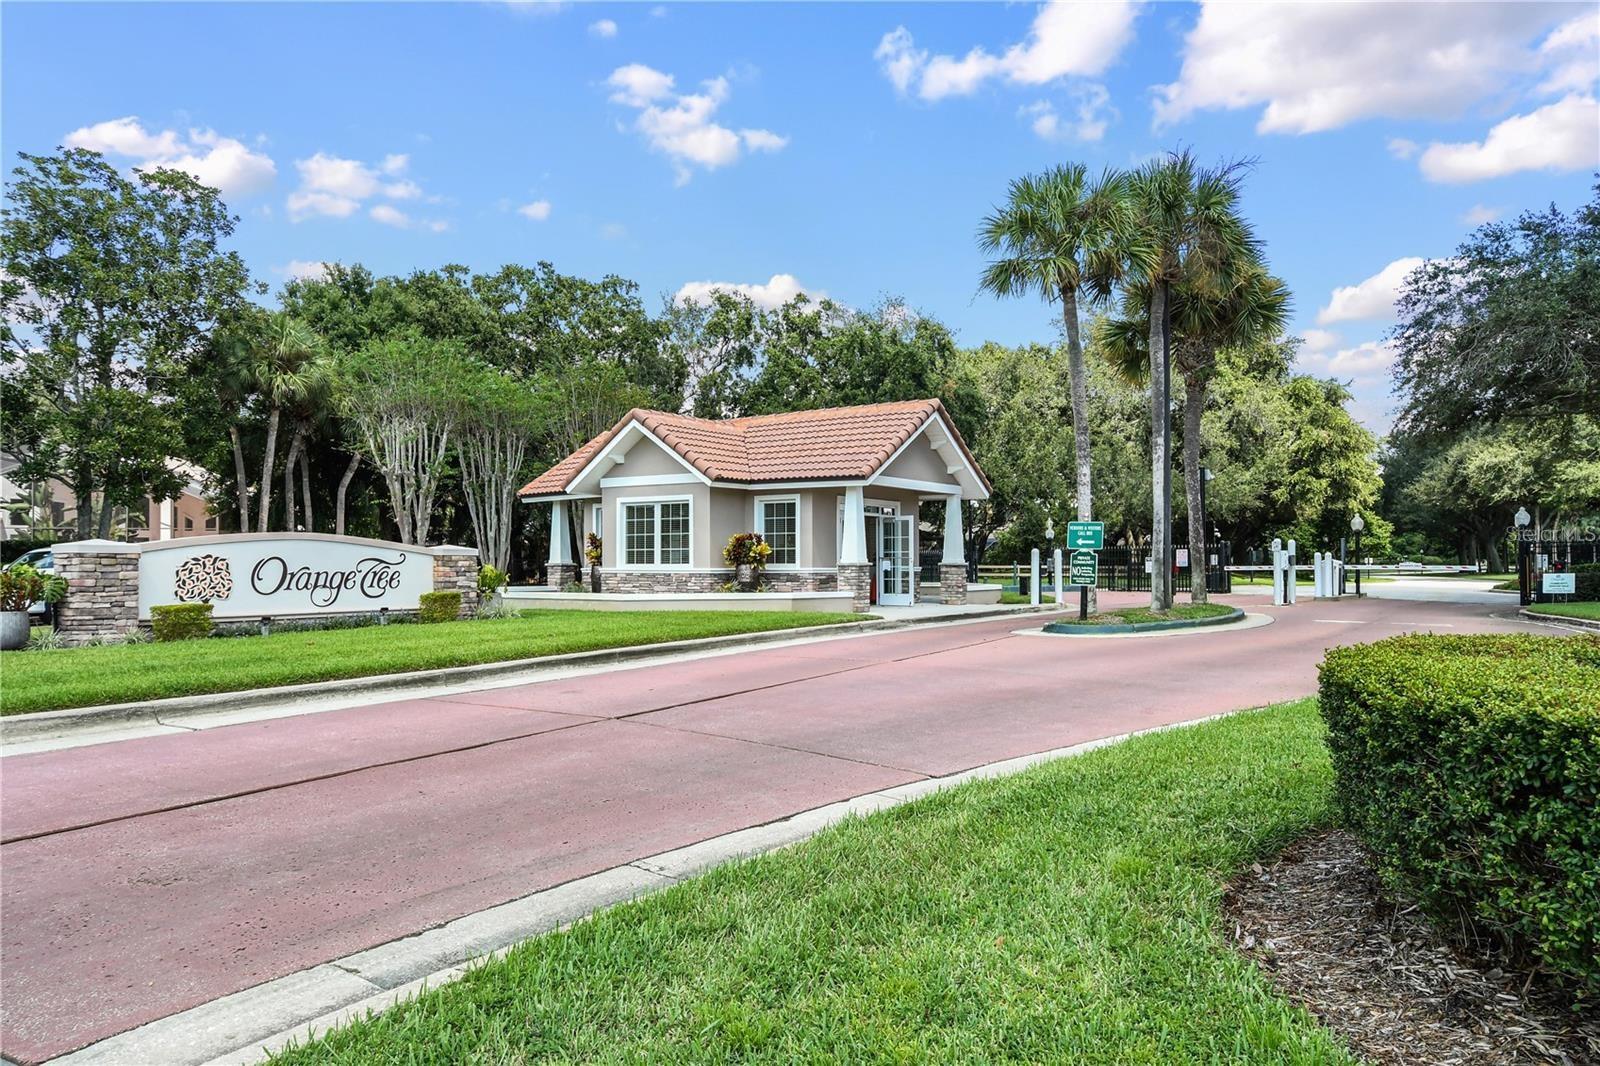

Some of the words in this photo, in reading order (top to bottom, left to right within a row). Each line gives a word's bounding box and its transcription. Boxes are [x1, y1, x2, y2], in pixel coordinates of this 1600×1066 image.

[251, 556, 356, 608] Orange
[356, 553, 406, 599] Tree
[1072, 566, 1082, 576] NO
